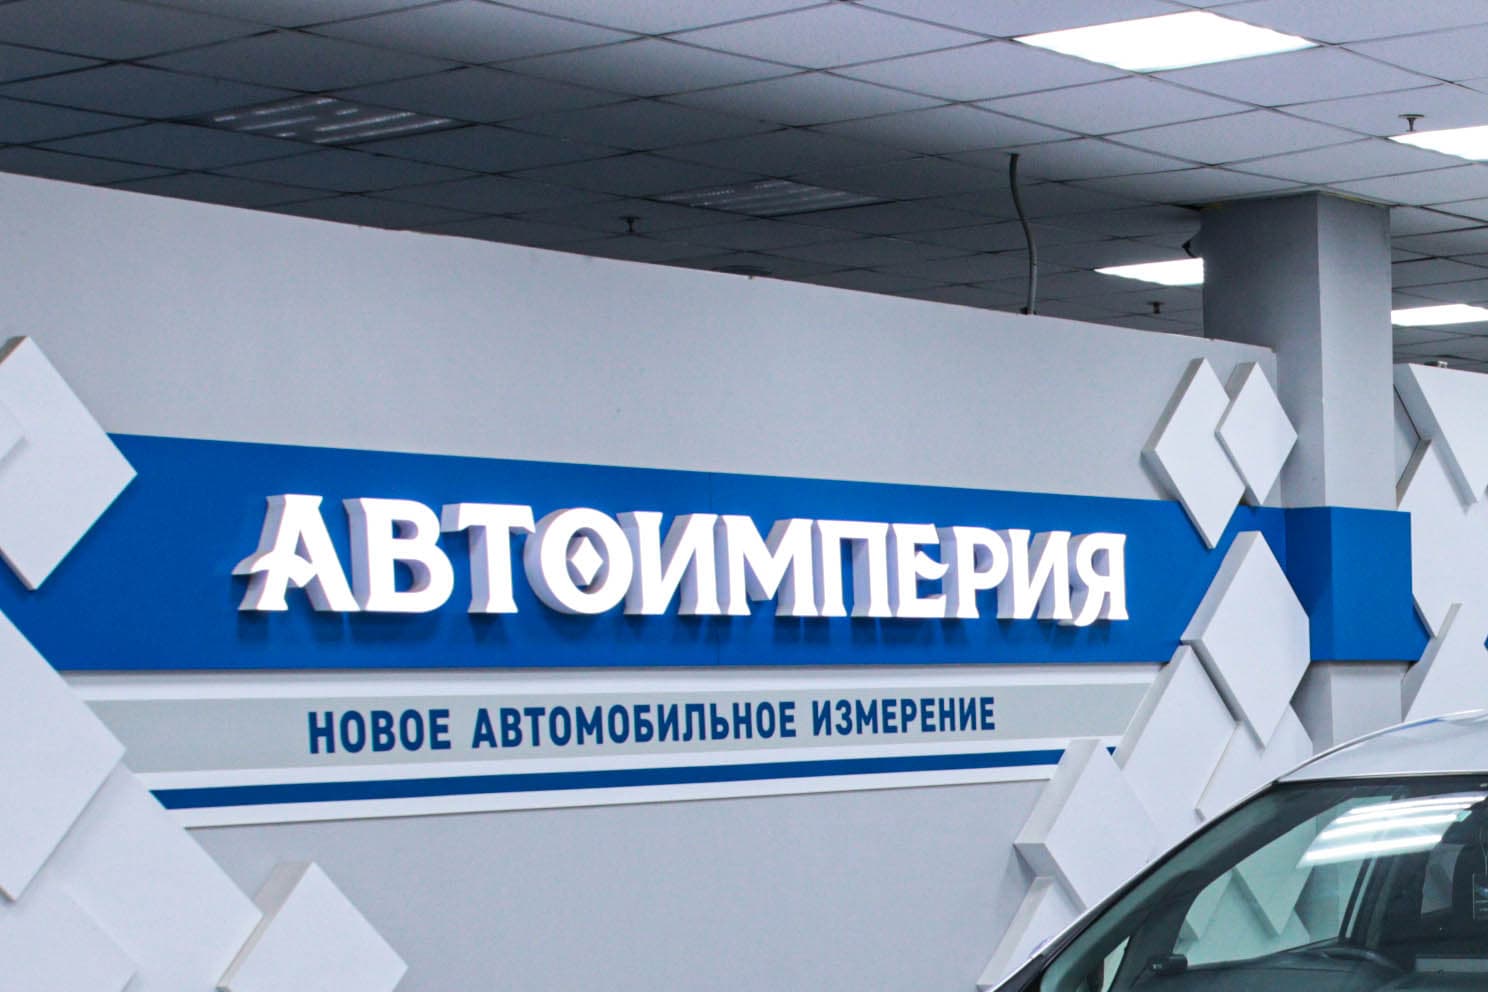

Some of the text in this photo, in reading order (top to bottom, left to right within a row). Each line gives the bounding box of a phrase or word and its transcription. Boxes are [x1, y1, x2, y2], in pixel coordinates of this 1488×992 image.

[232, 493, 1130, 627] АВТОИМПЕРИЯ
[308, 696, 996, 755] НОВОЕ АВТОМОБИЛЬНОЕ ИЗМЕРЕНИЕ
